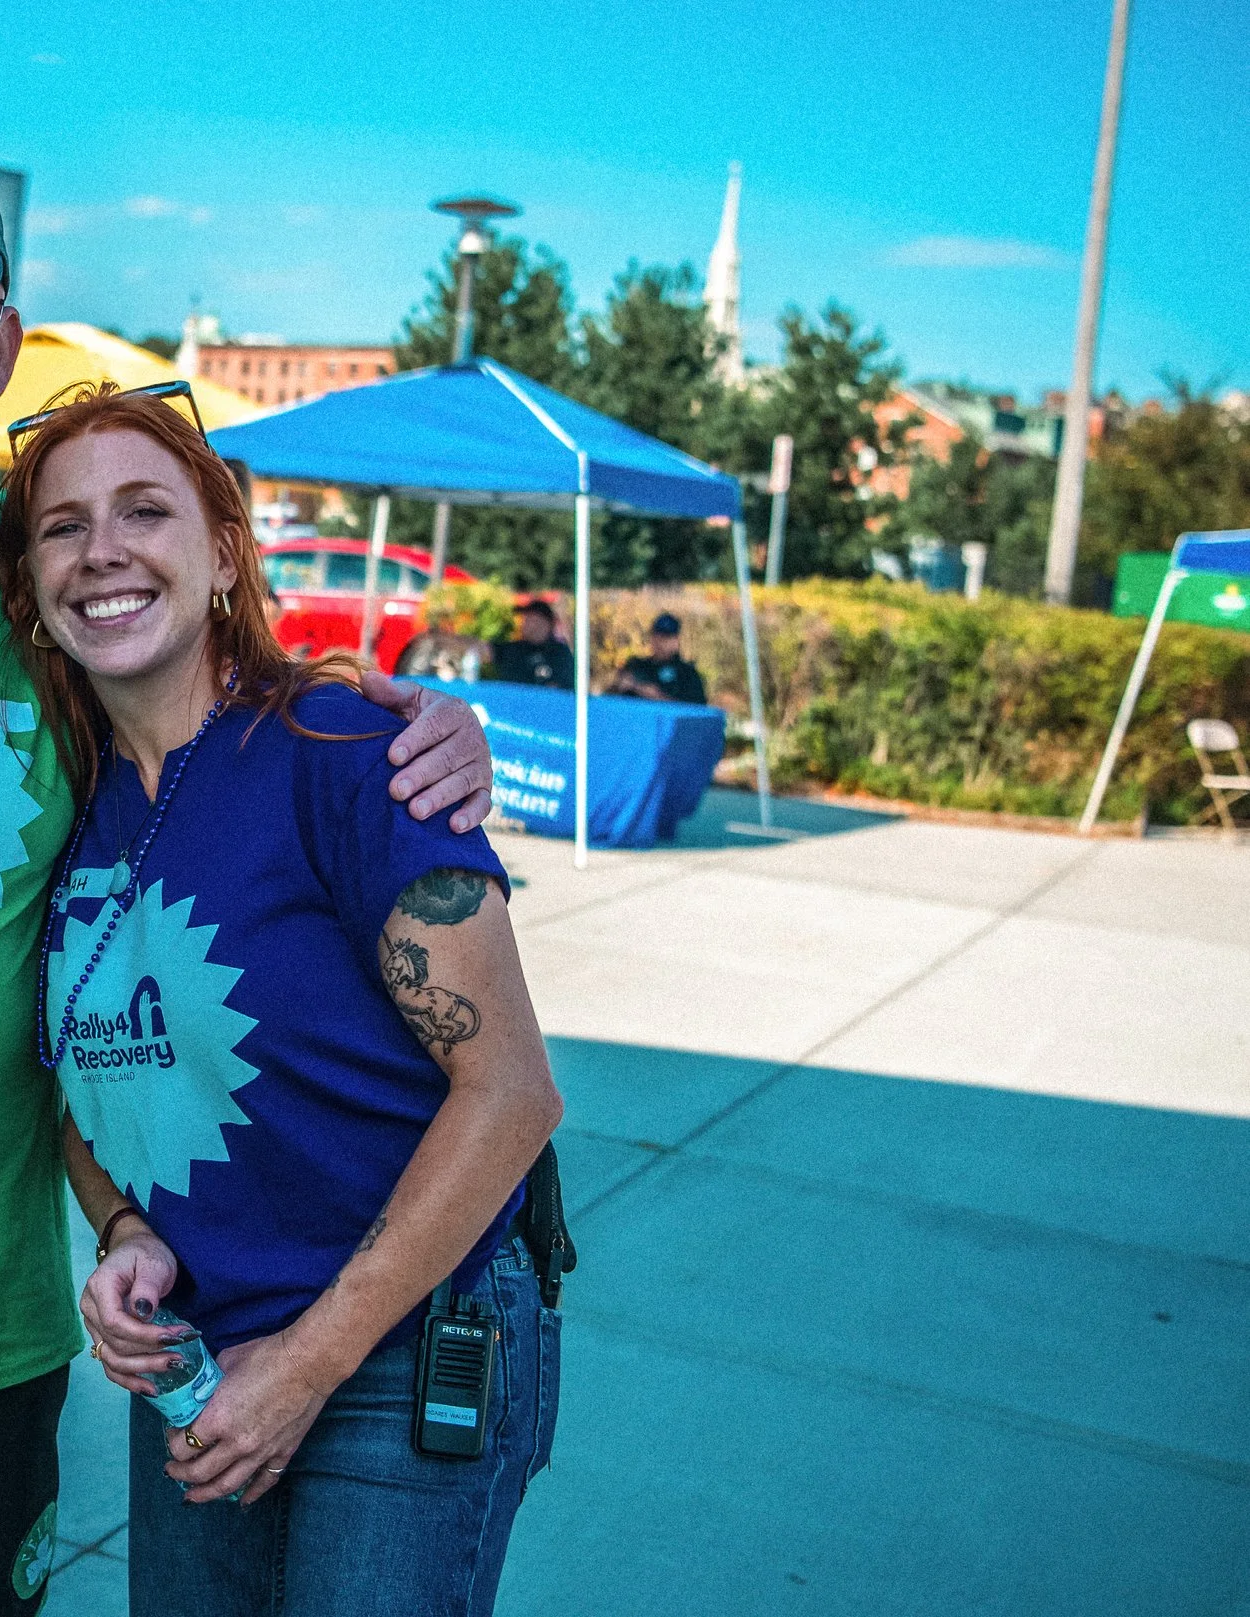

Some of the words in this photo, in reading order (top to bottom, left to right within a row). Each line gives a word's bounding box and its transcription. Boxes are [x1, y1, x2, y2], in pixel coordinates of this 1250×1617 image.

[66, 1011, 130, 1045] Rally4
[71, 1040, 176, 1071] Recovery
[81, 1073, 104, 1084] RHODE
[105, 1071, 135, 1083] ISLAND
[442, 1325, 483, 1338] RETEVIS
